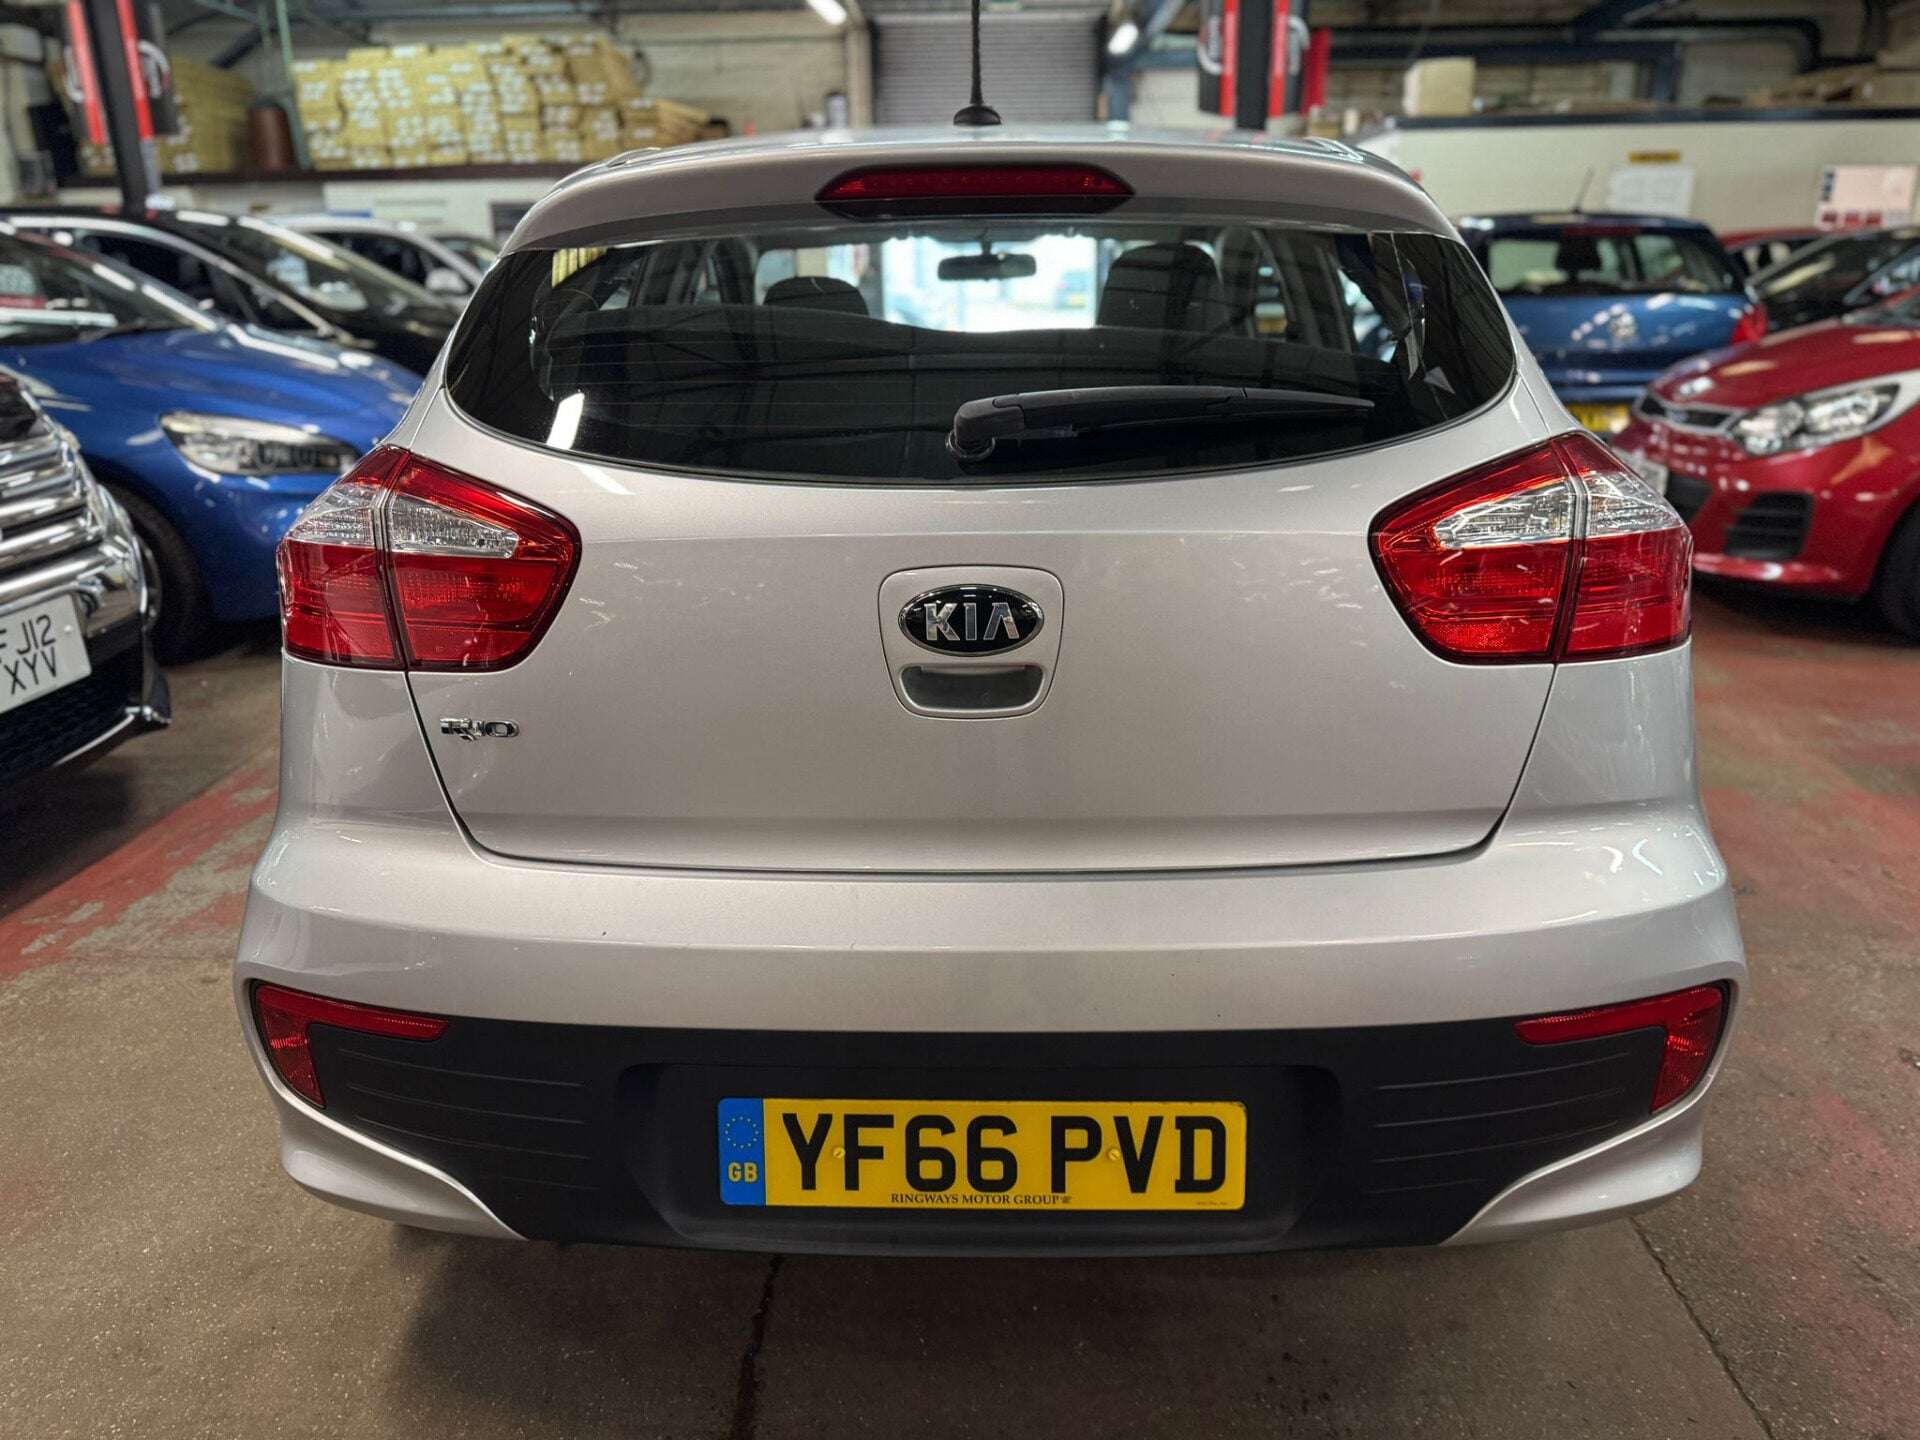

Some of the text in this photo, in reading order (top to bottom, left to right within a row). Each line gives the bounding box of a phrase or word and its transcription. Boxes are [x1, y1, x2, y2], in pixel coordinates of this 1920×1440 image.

[924, 602, 1020, 641] KIA
[4, 646, 57, 695] XYV
[728, 1161, 758, 1183] GB
[782, 1113, 1227, 1193] YF66 PVD
[891, 1193, 958, 1204] RINGWAYS
[962, 1194, 1010, 1205] MOTOR
[1013, 1194, 1061, 1205] GROUP
